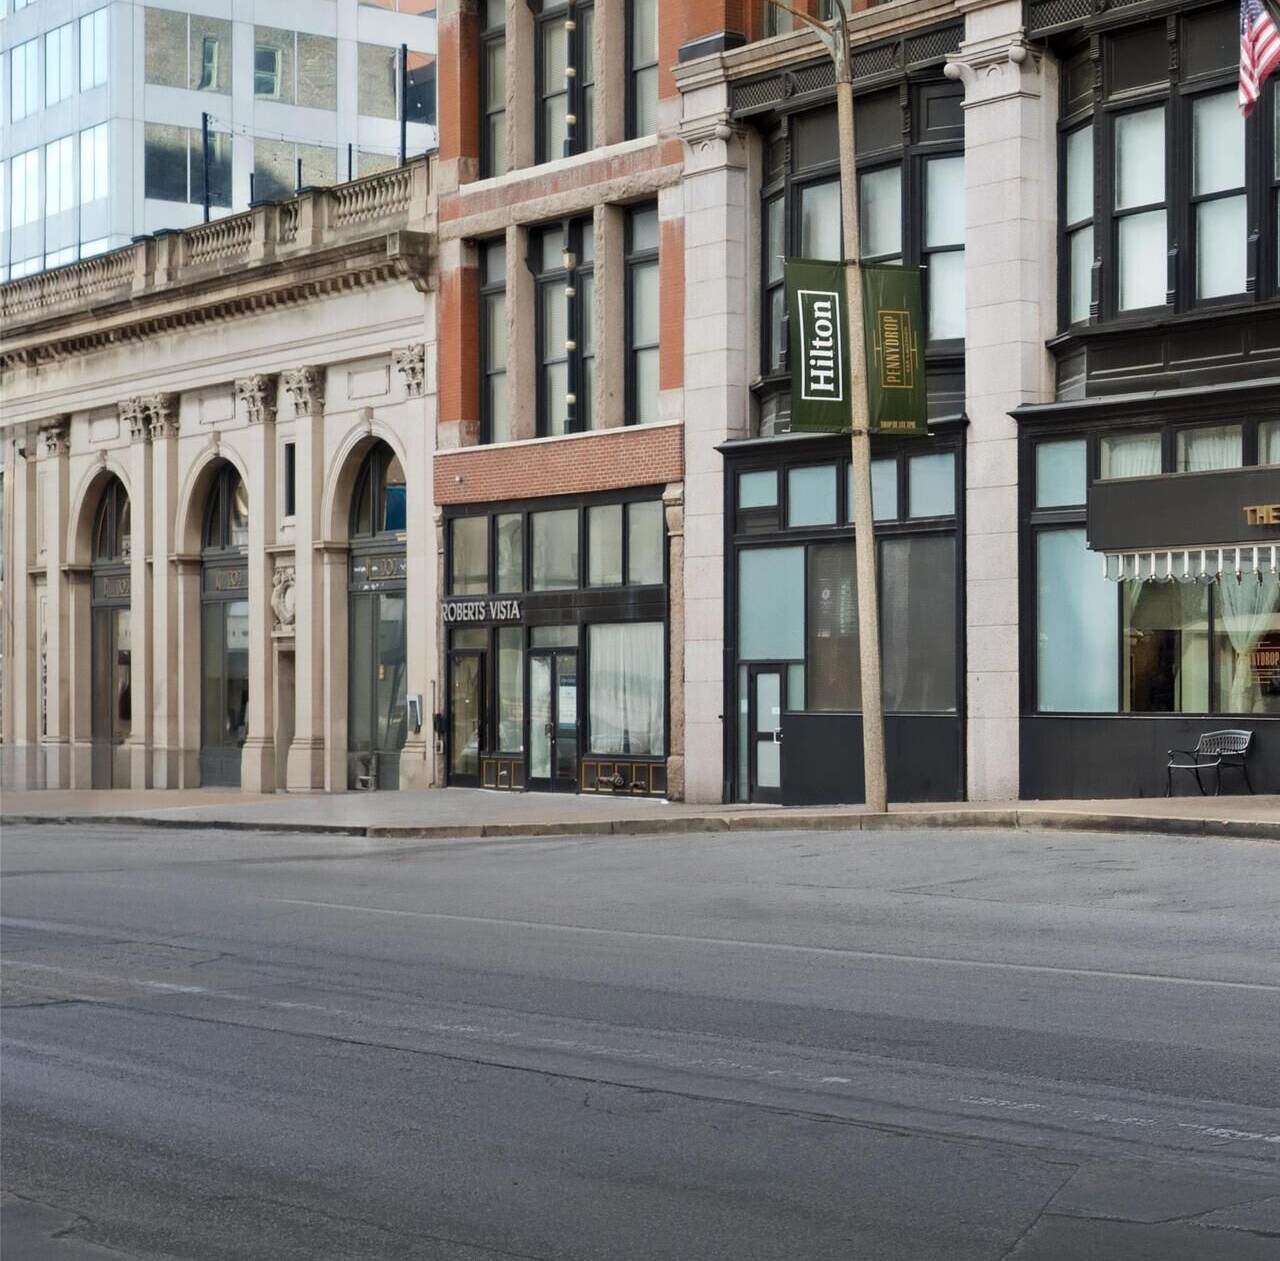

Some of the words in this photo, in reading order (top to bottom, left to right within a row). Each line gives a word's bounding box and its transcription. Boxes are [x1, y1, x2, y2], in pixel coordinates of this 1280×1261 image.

[810, 300, 834, 392] Hilton
[883, 315, 901, 383] PENNYDROP
[442, 601, 486, 621] ROBERTS
[489, 600, 520, 619] VISTA
